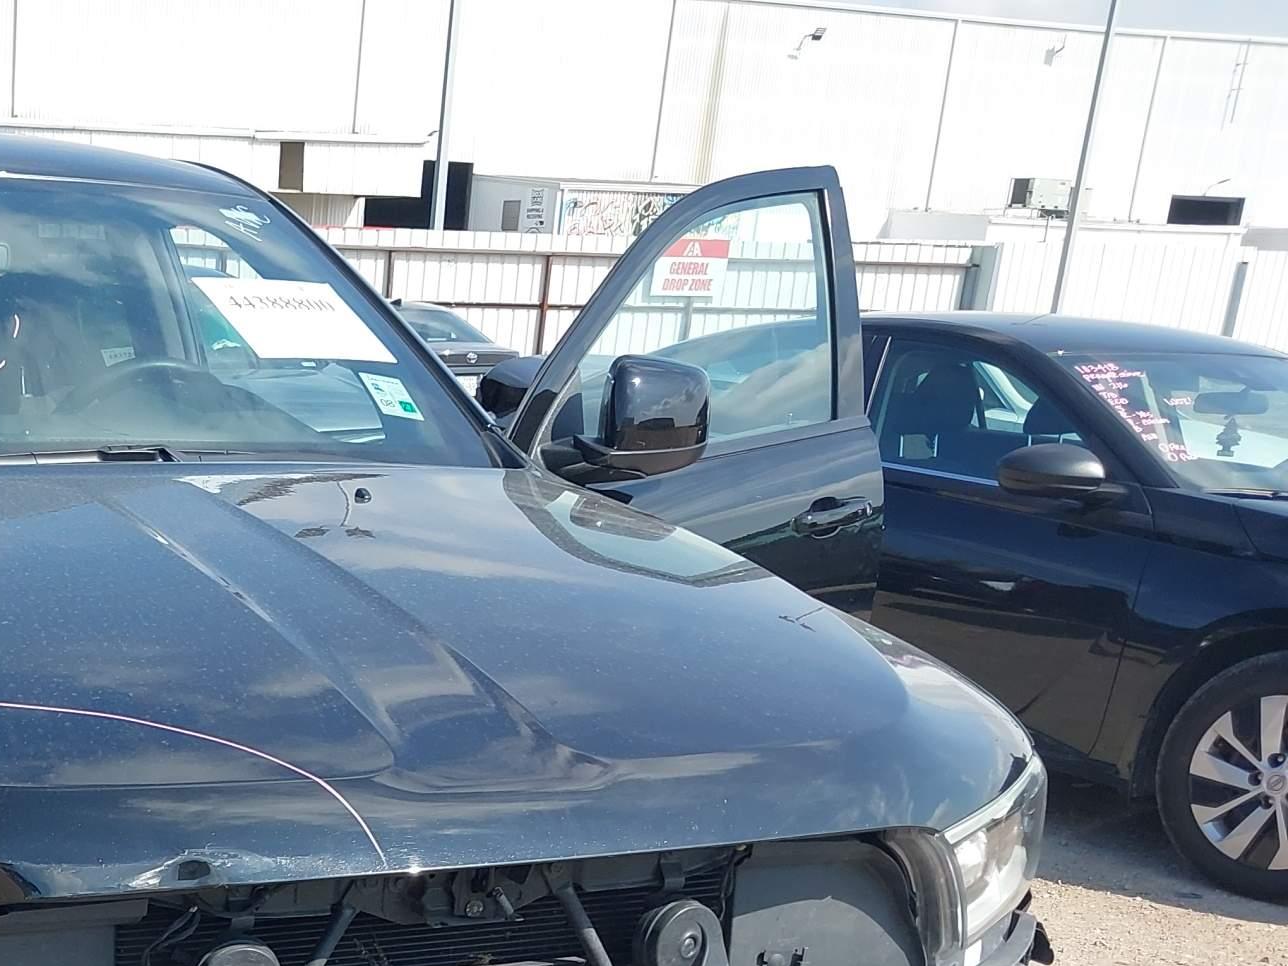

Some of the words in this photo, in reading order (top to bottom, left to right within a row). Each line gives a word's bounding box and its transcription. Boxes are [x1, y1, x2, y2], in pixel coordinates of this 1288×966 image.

[669, 261, 710, 276] GENERAL
[662, 278, 689, 292] DROP
[688, 278, 713, 292] ZONE
